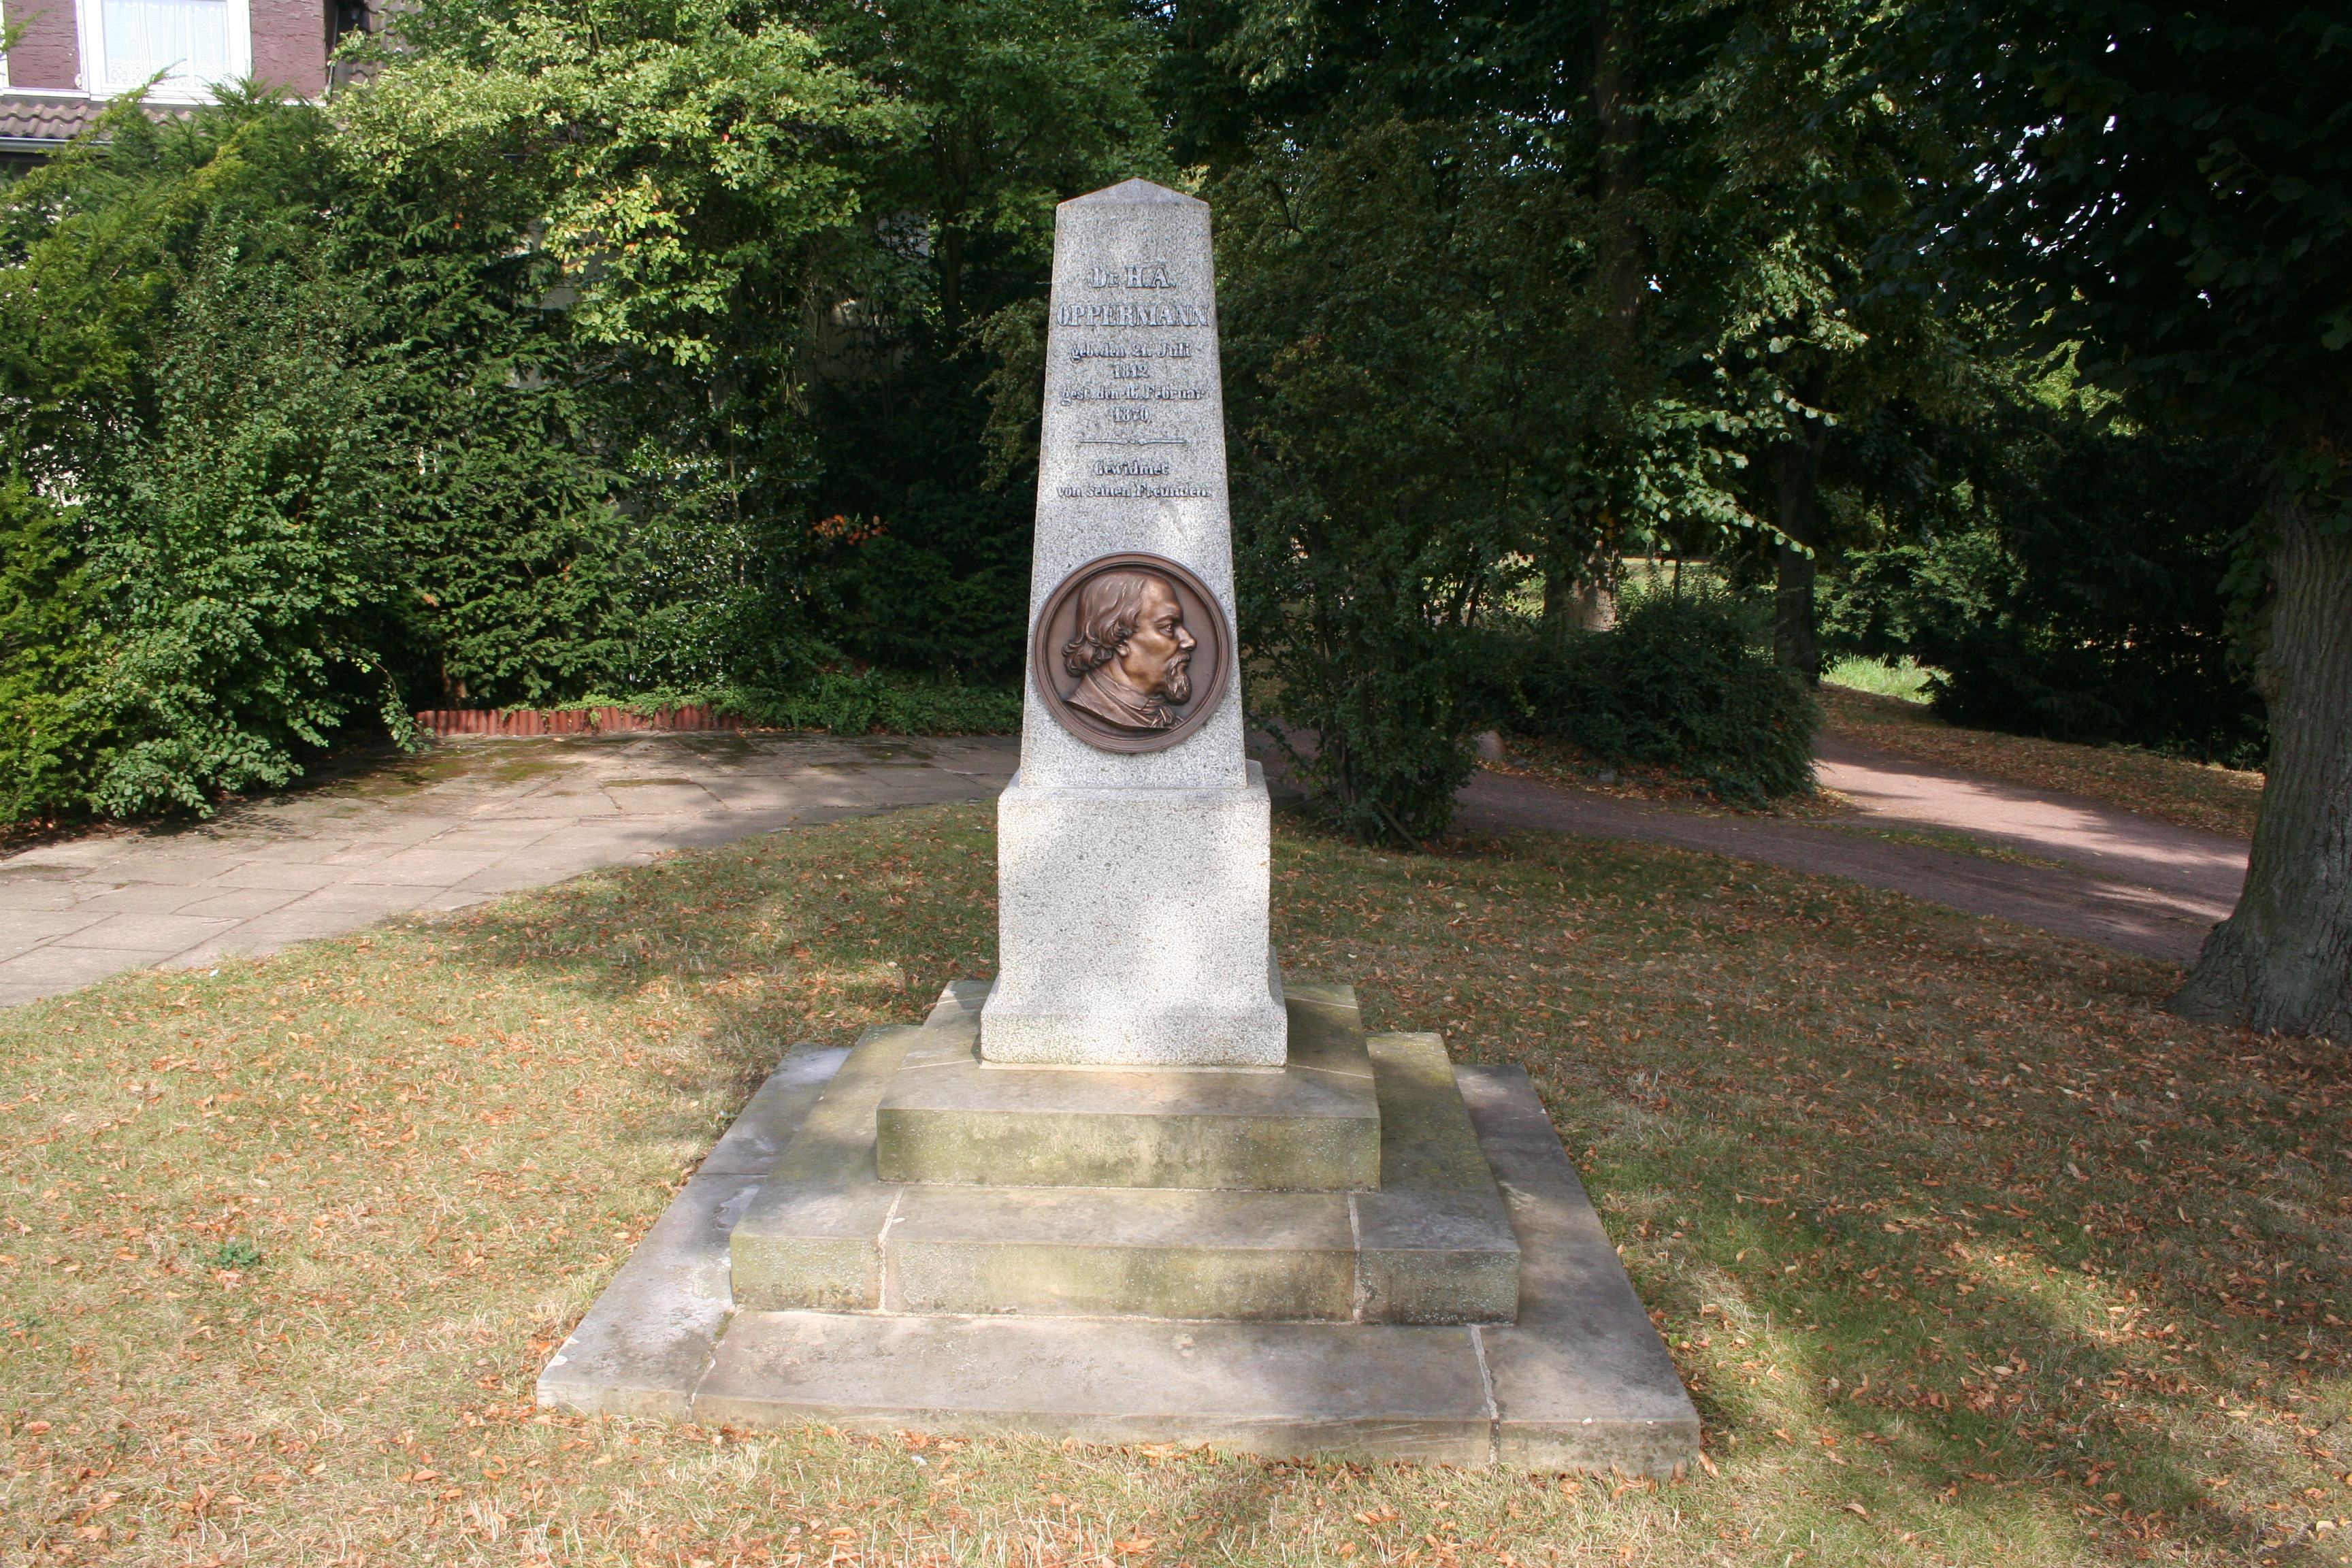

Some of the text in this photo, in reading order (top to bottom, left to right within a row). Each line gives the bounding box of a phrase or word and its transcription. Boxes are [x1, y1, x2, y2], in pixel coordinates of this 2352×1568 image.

[1056, 304, 1210, 327] OPPERMANN
[1157, 342, 1192, 357] Juli
[1113, 364, 1150, 378] 1812
[1096, 385, 1120, 399] den
[1143, 385, 1203, 400] Februar
[1113, 407, 1150, 423] 1870
[1094, 460, 1170, 476] Gewidmet
[1056, 486, 1081, 497] von
[1086, 484, 1131, 497] seinen
